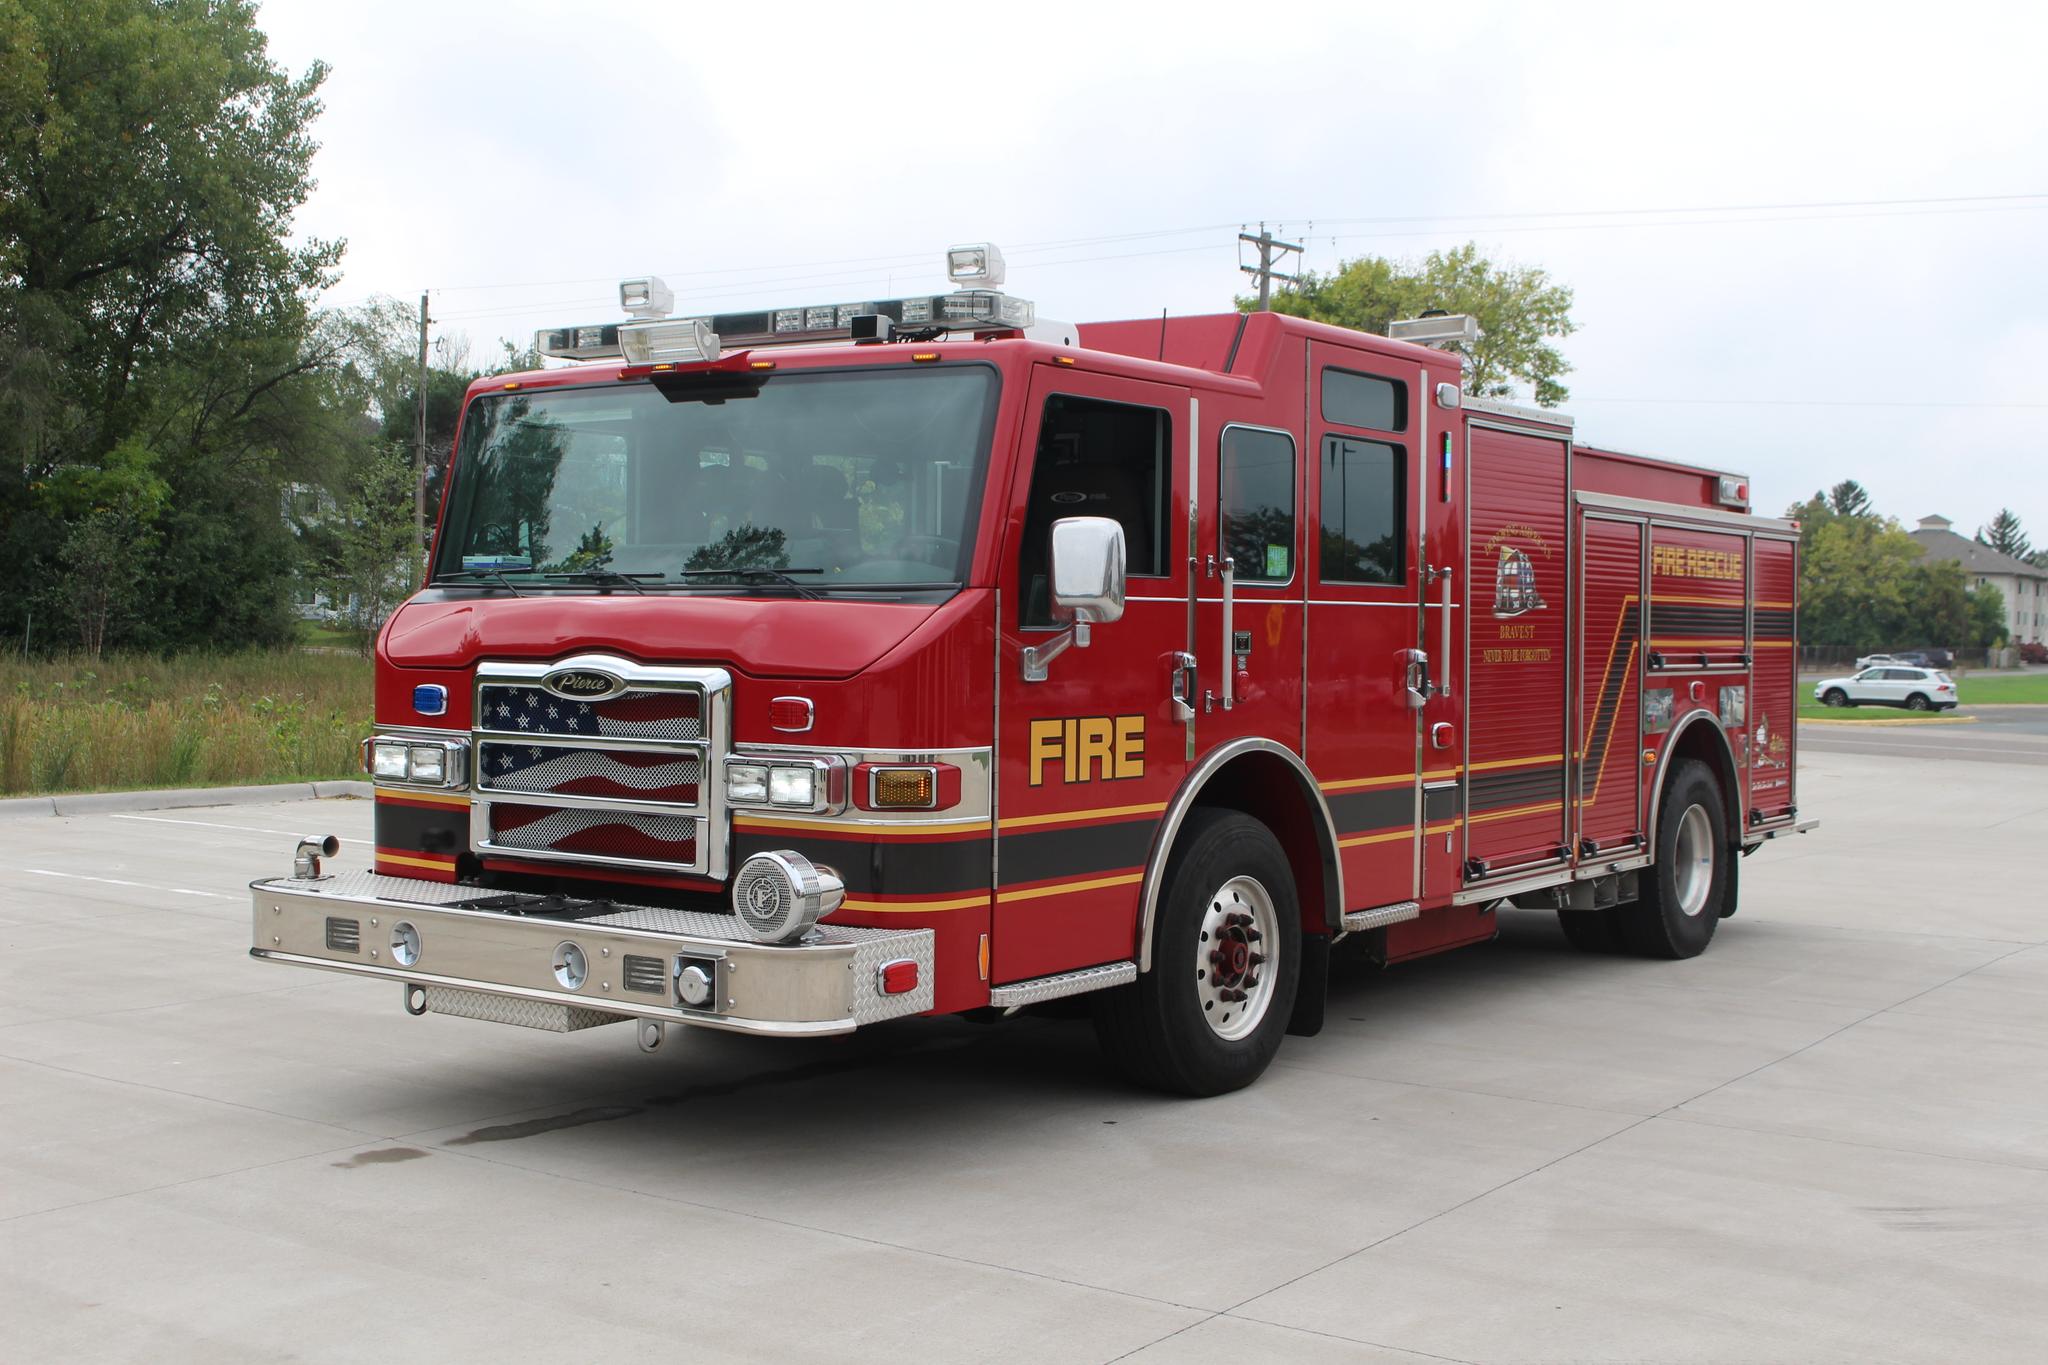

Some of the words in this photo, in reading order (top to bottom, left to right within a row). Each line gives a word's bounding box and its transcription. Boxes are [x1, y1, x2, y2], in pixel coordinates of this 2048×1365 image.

[1653, 545, 1686, 577] FIRE
[1686, 548, 1742, 580] RESCUE
[1500, 625, 1535, 639] BRAVEST
[559, 673, 606, 690] Pierce
[1029, 715, 1145, 787] FIRE
